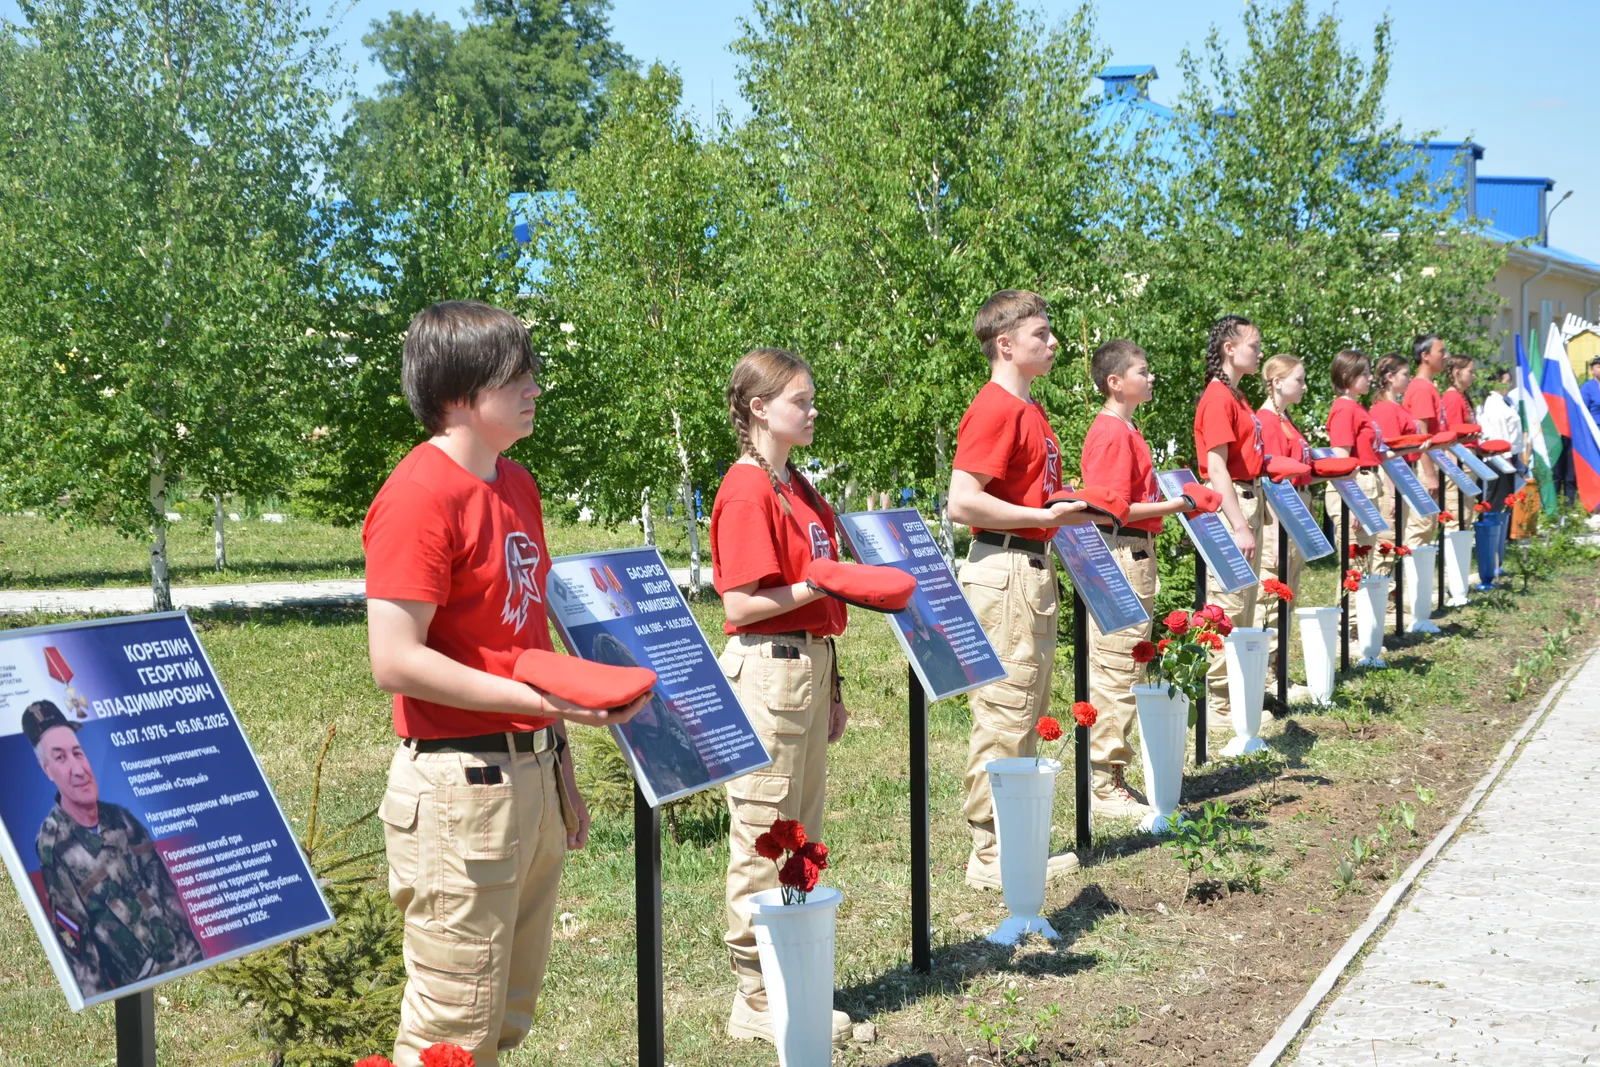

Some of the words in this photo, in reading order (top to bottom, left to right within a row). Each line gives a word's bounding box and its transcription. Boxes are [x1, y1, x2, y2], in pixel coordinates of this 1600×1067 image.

[626, 564, 664, 580] БАСЫРОВ
[642, 580, 671, 595] ИЛЬНУР
[636, 596, 682, 614] РАМИЛЕВИЧ
[123, 637, 193, 662] КОРЕЛИН
[137, 657, 204, 685] ГЕОРГИЙ
[92, 683, 215, 718] ВЛАДИМИРОВИЧ
[110, 724, 168, 747] 03.07.1976
[175, 713, 229, 734] 05.06.2025
[121, 756, 162, 771] Помощник
[162, 745, 220, 765] гранатометчика,
[128, 769, 163, 786] рядовой.
[133, 780, 173, 797] Позывной
[173, 773, 209, 788] «Старый»
[145, 807, 187, 823] Награжден
[187, 799, 218, 814] орденом
[218, 790, 259, 806] «Мужества»
[152, 816, 198, 837] (посмертно)
[163, 843, 207, 861] Героически
[206, 836, 229, 850] погиб
[228, 834, 243, 846] при
[170, 855, 215, 874] исполнении
[215, 847, 251, 860] воинского
[251, 841, 272, 853] долга
[271, 839, 278, 847] в
[176, 875, 194, 887] ходе
[195, 861, 243, 882] специальной
[242, 853, 272, 869] военной
[182, 884, 218, 900] операции
[219, 880, 228, 889] на
[228, 869, 269, 887] территории
[187, 896, 224, 915] Донецкой
[223, 886, 260, 903] Народной
[259, 873, 303, 892] Республики,
[193, 899, 259, 927] Красноармейский
[258, 894, 283, 909] район,
[200, 920, 243, 939] с.Шевченко
[243, 917, 249, 926] в
[248, 910, 270, 924] 2025г.
